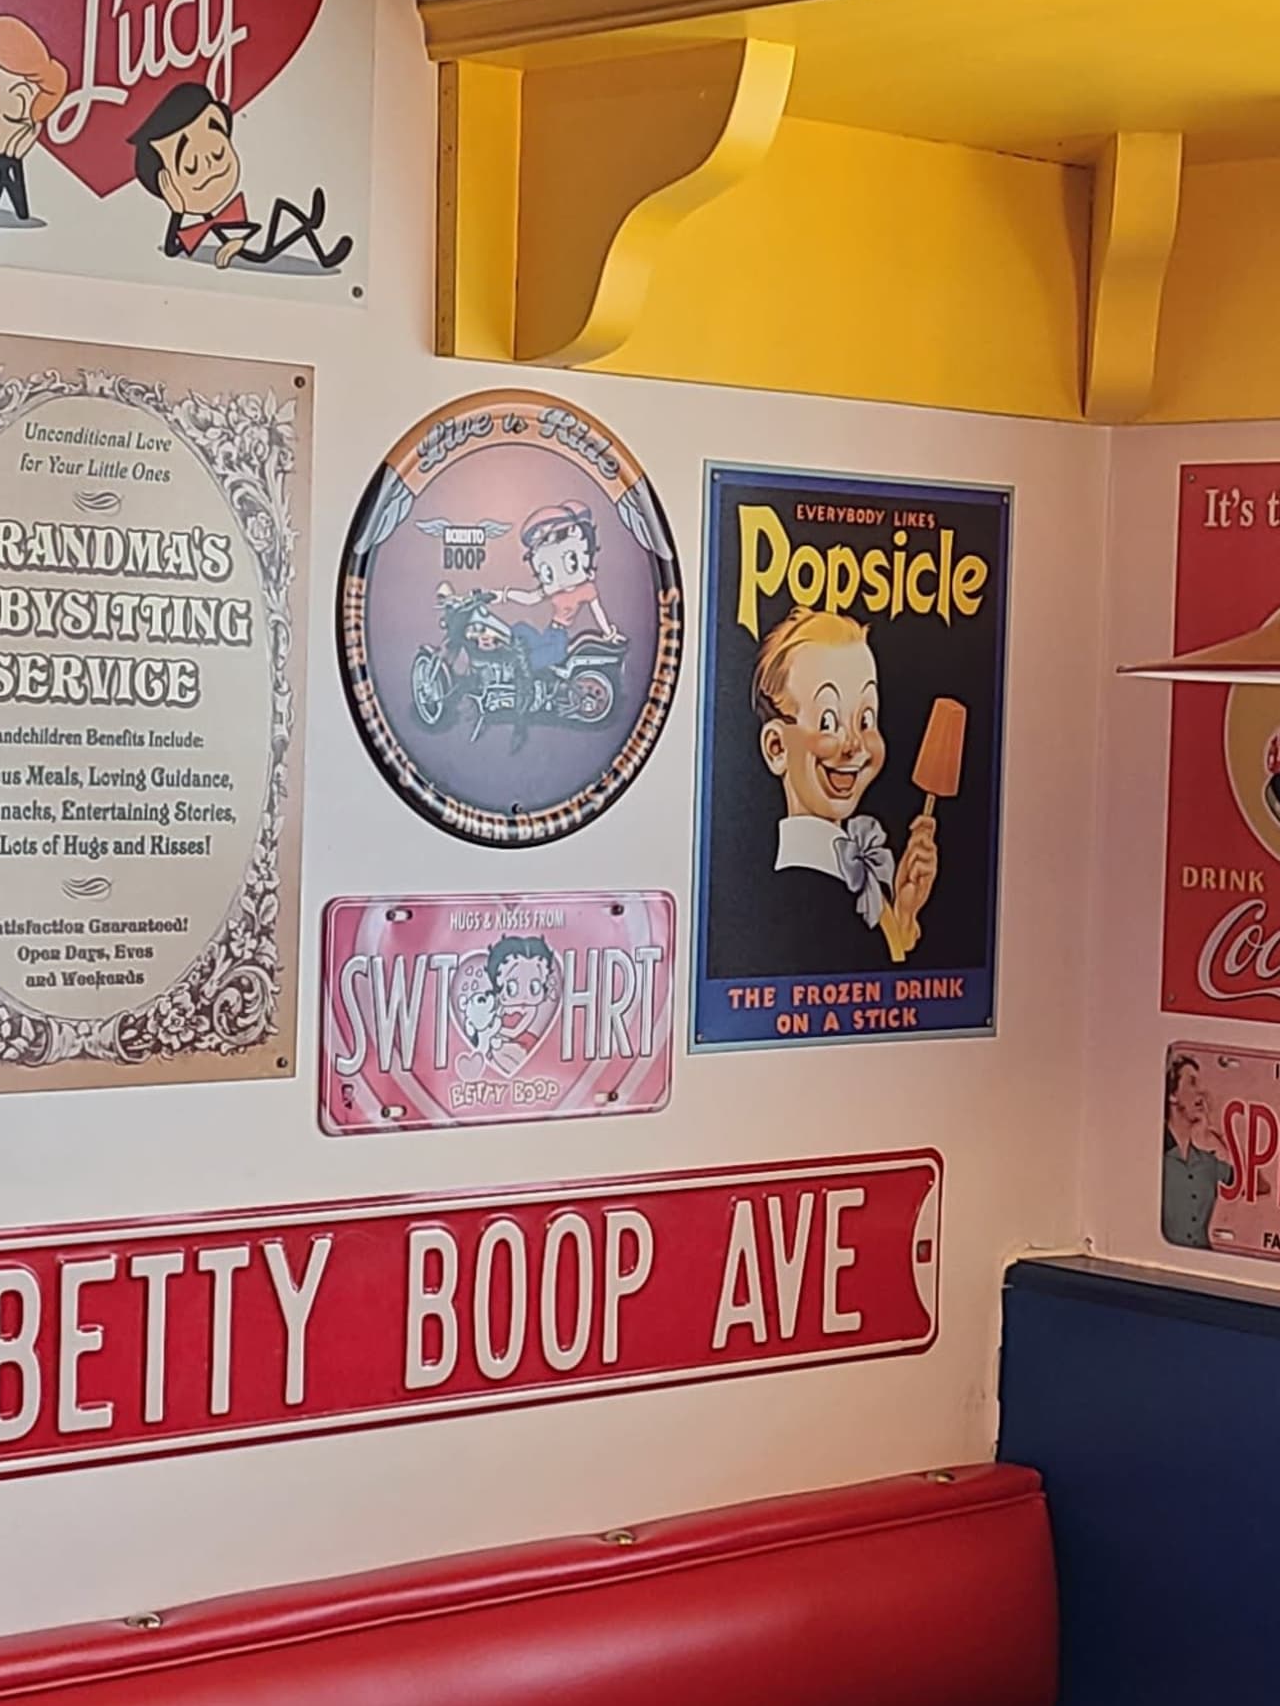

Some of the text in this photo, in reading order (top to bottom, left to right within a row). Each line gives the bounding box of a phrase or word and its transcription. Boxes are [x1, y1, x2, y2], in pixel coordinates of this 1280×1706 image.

[23, 421, 173, 454] Unconditional Love
[415, 412, 494, 474] Live
[48, 455, 172, 483] Your Ones
[795, 503, 886, 528] EVERYBODY
[443, 547, 487, 571] BOOP
[736, 501, 989, 643] Popsicle
[87, 767, 147, 792] Loving
[60, 800, 170, 827] Entertaining
[41, 835, 62, 856] of
[63, 834, 109, 860] Hugs
[112, 836, 147, 857] and
[1182, 864, 1266, 894] DRINK
[335, 945, 664, 1077] SWT HRT
[728, 983, 882, 1010] THE FROZEN
[776, 1006, 918, 1036] ON STICK
[449, 1080, 508, 1110] BETTY
[404, 1207, 655, 1391] BOOP
[712, 1186, 870, 1352] AVE
